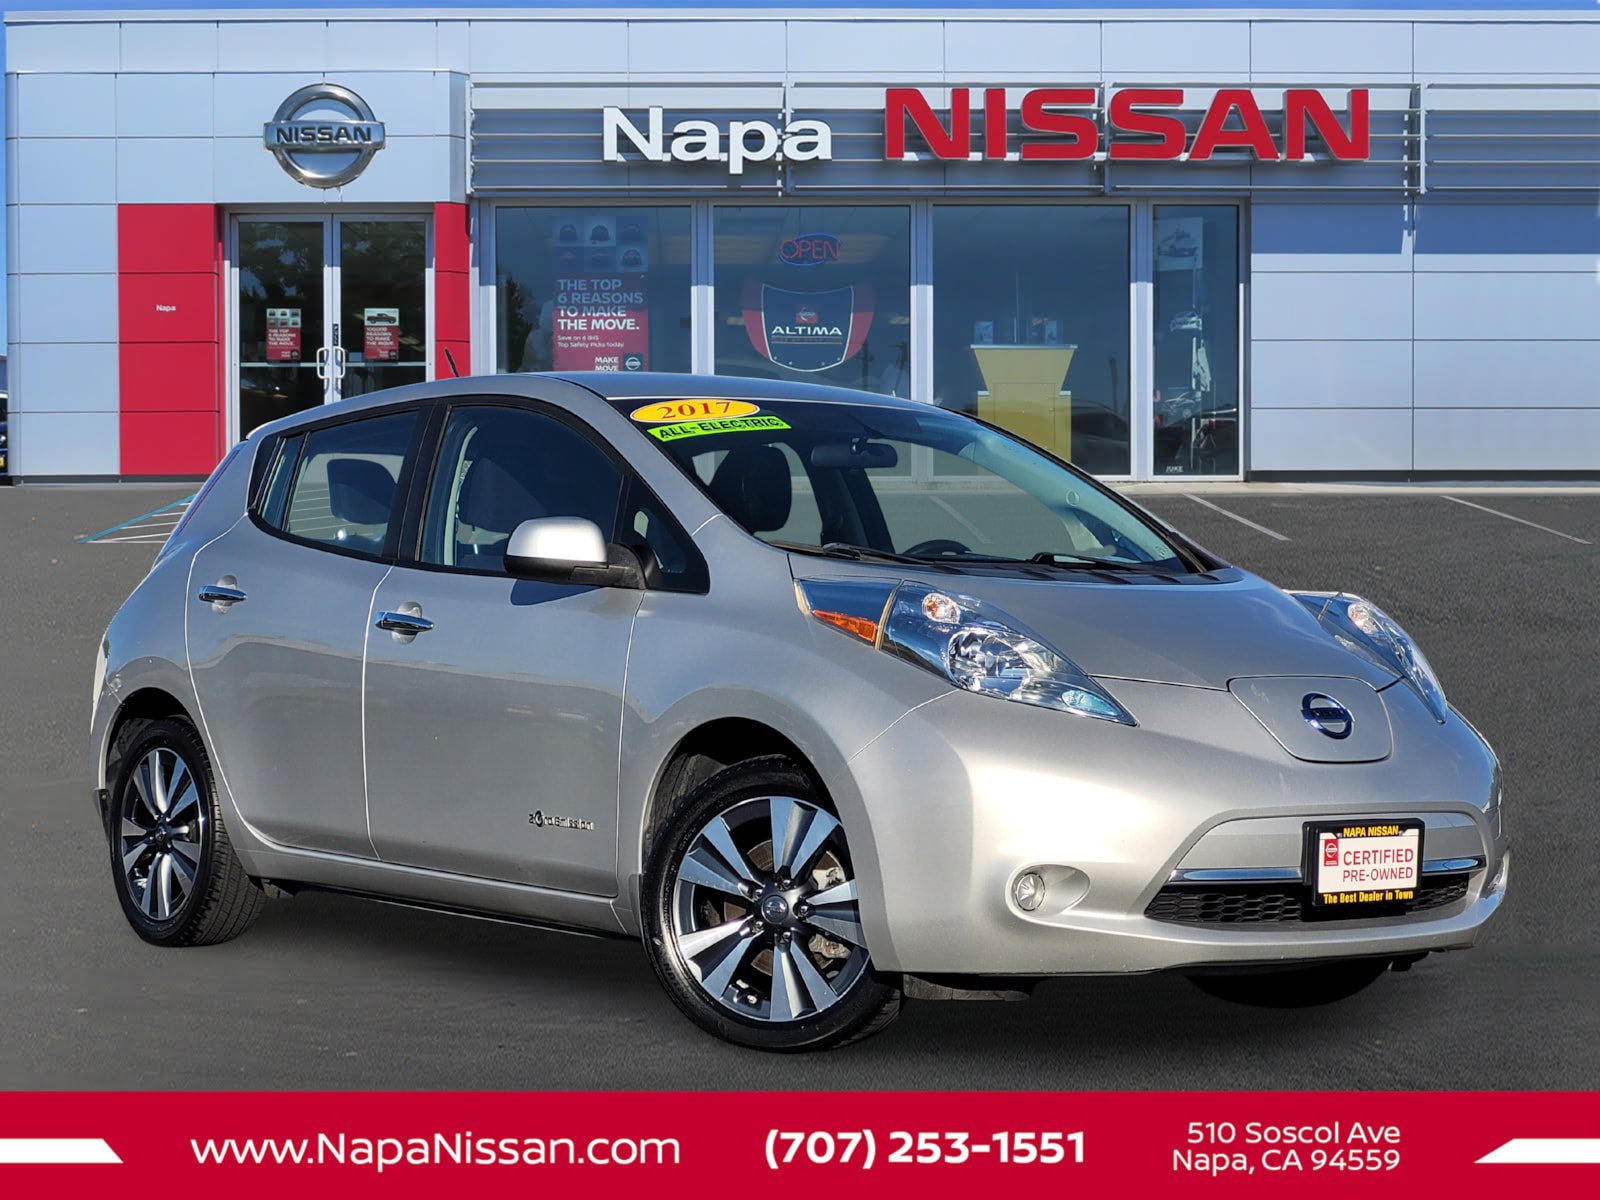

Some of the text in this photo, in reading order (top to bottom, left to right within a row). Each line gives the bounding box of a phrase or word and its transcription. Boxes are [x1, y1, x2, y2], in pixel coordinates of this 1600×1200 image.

[276, 126, 372, 143] NISSAN
[602, 87, 1369, 174] Napa NISSAN
[781, 239, 840, 260] OPEN
[557, 279, 622, 291] THE TOP
[558, 292, 643, 304] 6 REASONS
[156, 304, 176, 312] Napa
[557, 305, 626, 317] TO MAKE
[557, 318, 640, 330] THE MOVE.
[771, 326, 843, 335] ALTIMA
[595, 356, 619, 364] MAKE
[657, 402, 731, 419] 2017
[660, 417, 780, 439] ALL-ELECTRIC
[1343, 825, 1400, 838] NAPA NISSAN
[1343, 848, 1414, 866] CERTIFIED
[1343, 866, 1414, 882] PRE-OWNED
[1323, 889, 1414, 905] The Best Dealer in Town
